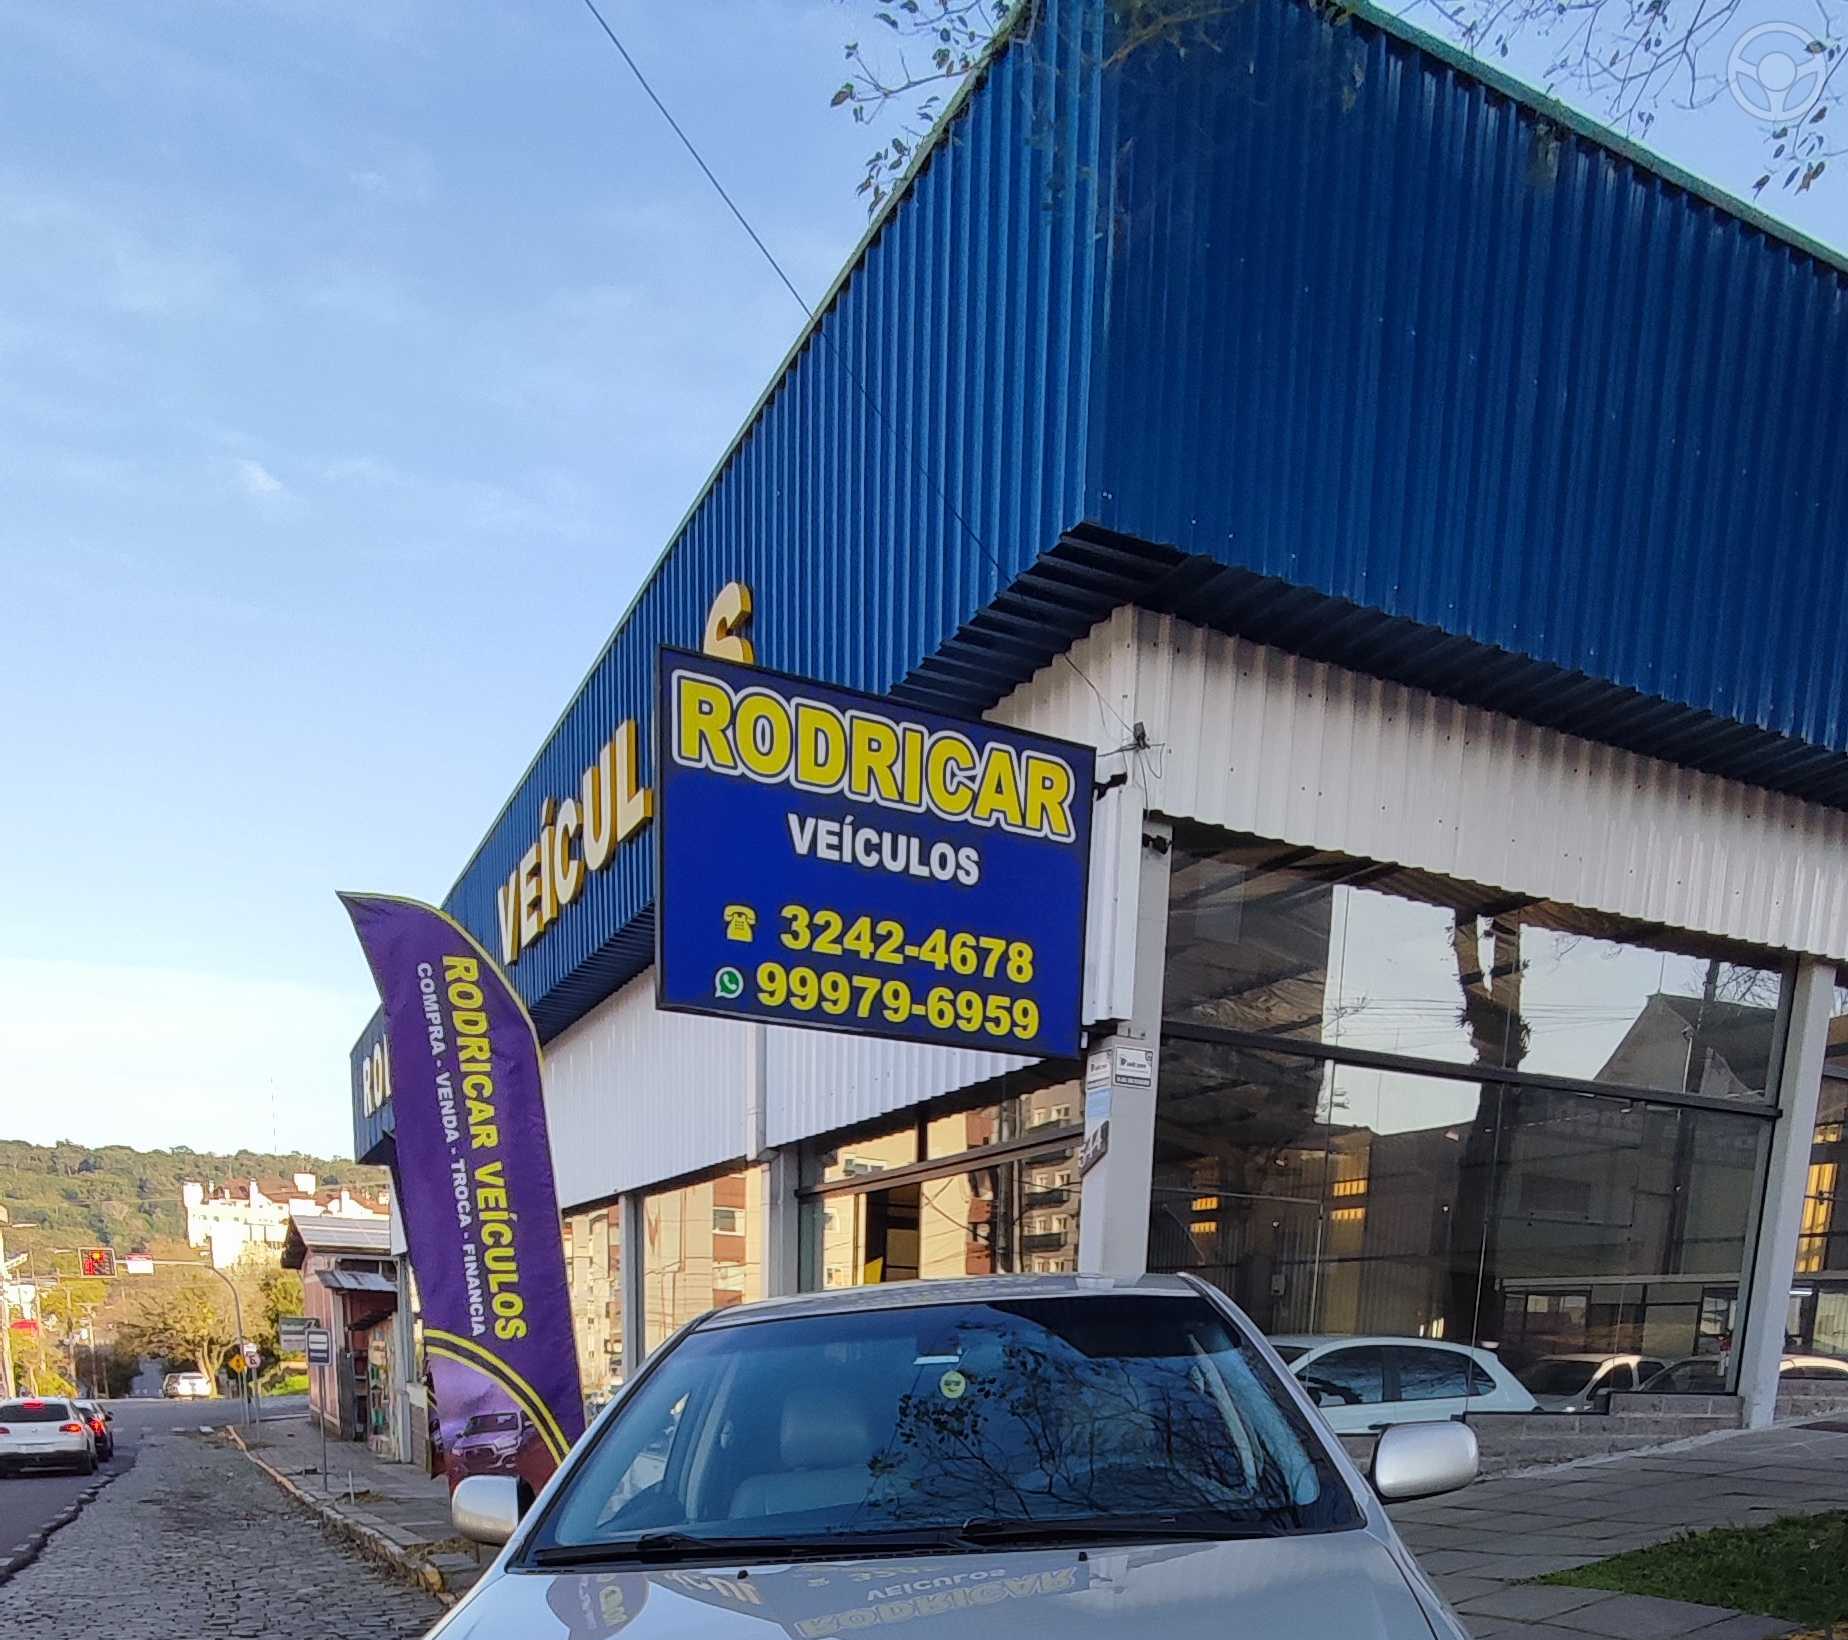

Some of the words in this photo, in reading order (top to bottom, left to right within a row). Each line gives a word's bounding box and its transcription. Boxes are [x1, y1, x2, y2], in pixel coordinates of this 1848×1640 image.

[673, 669, 1077, 843] RODRICAR
[788, 814, 980, 886] VEÍCULOS
[755, 961, 1040, 1040] 99979-6959
[779, 904, 1035, 984] 3242-4678
[417, 962, 446, 1056] COMPRA
[435, 1071, 460, 1143] VENDA
[451, 1158, 472, 1229] TROCA
[462, 1243, 487, 1337] FINANCIA
[442, 955, 499, 1149] RODRICAR
[474, 1160, 528, 1340] VEÍCULOS
